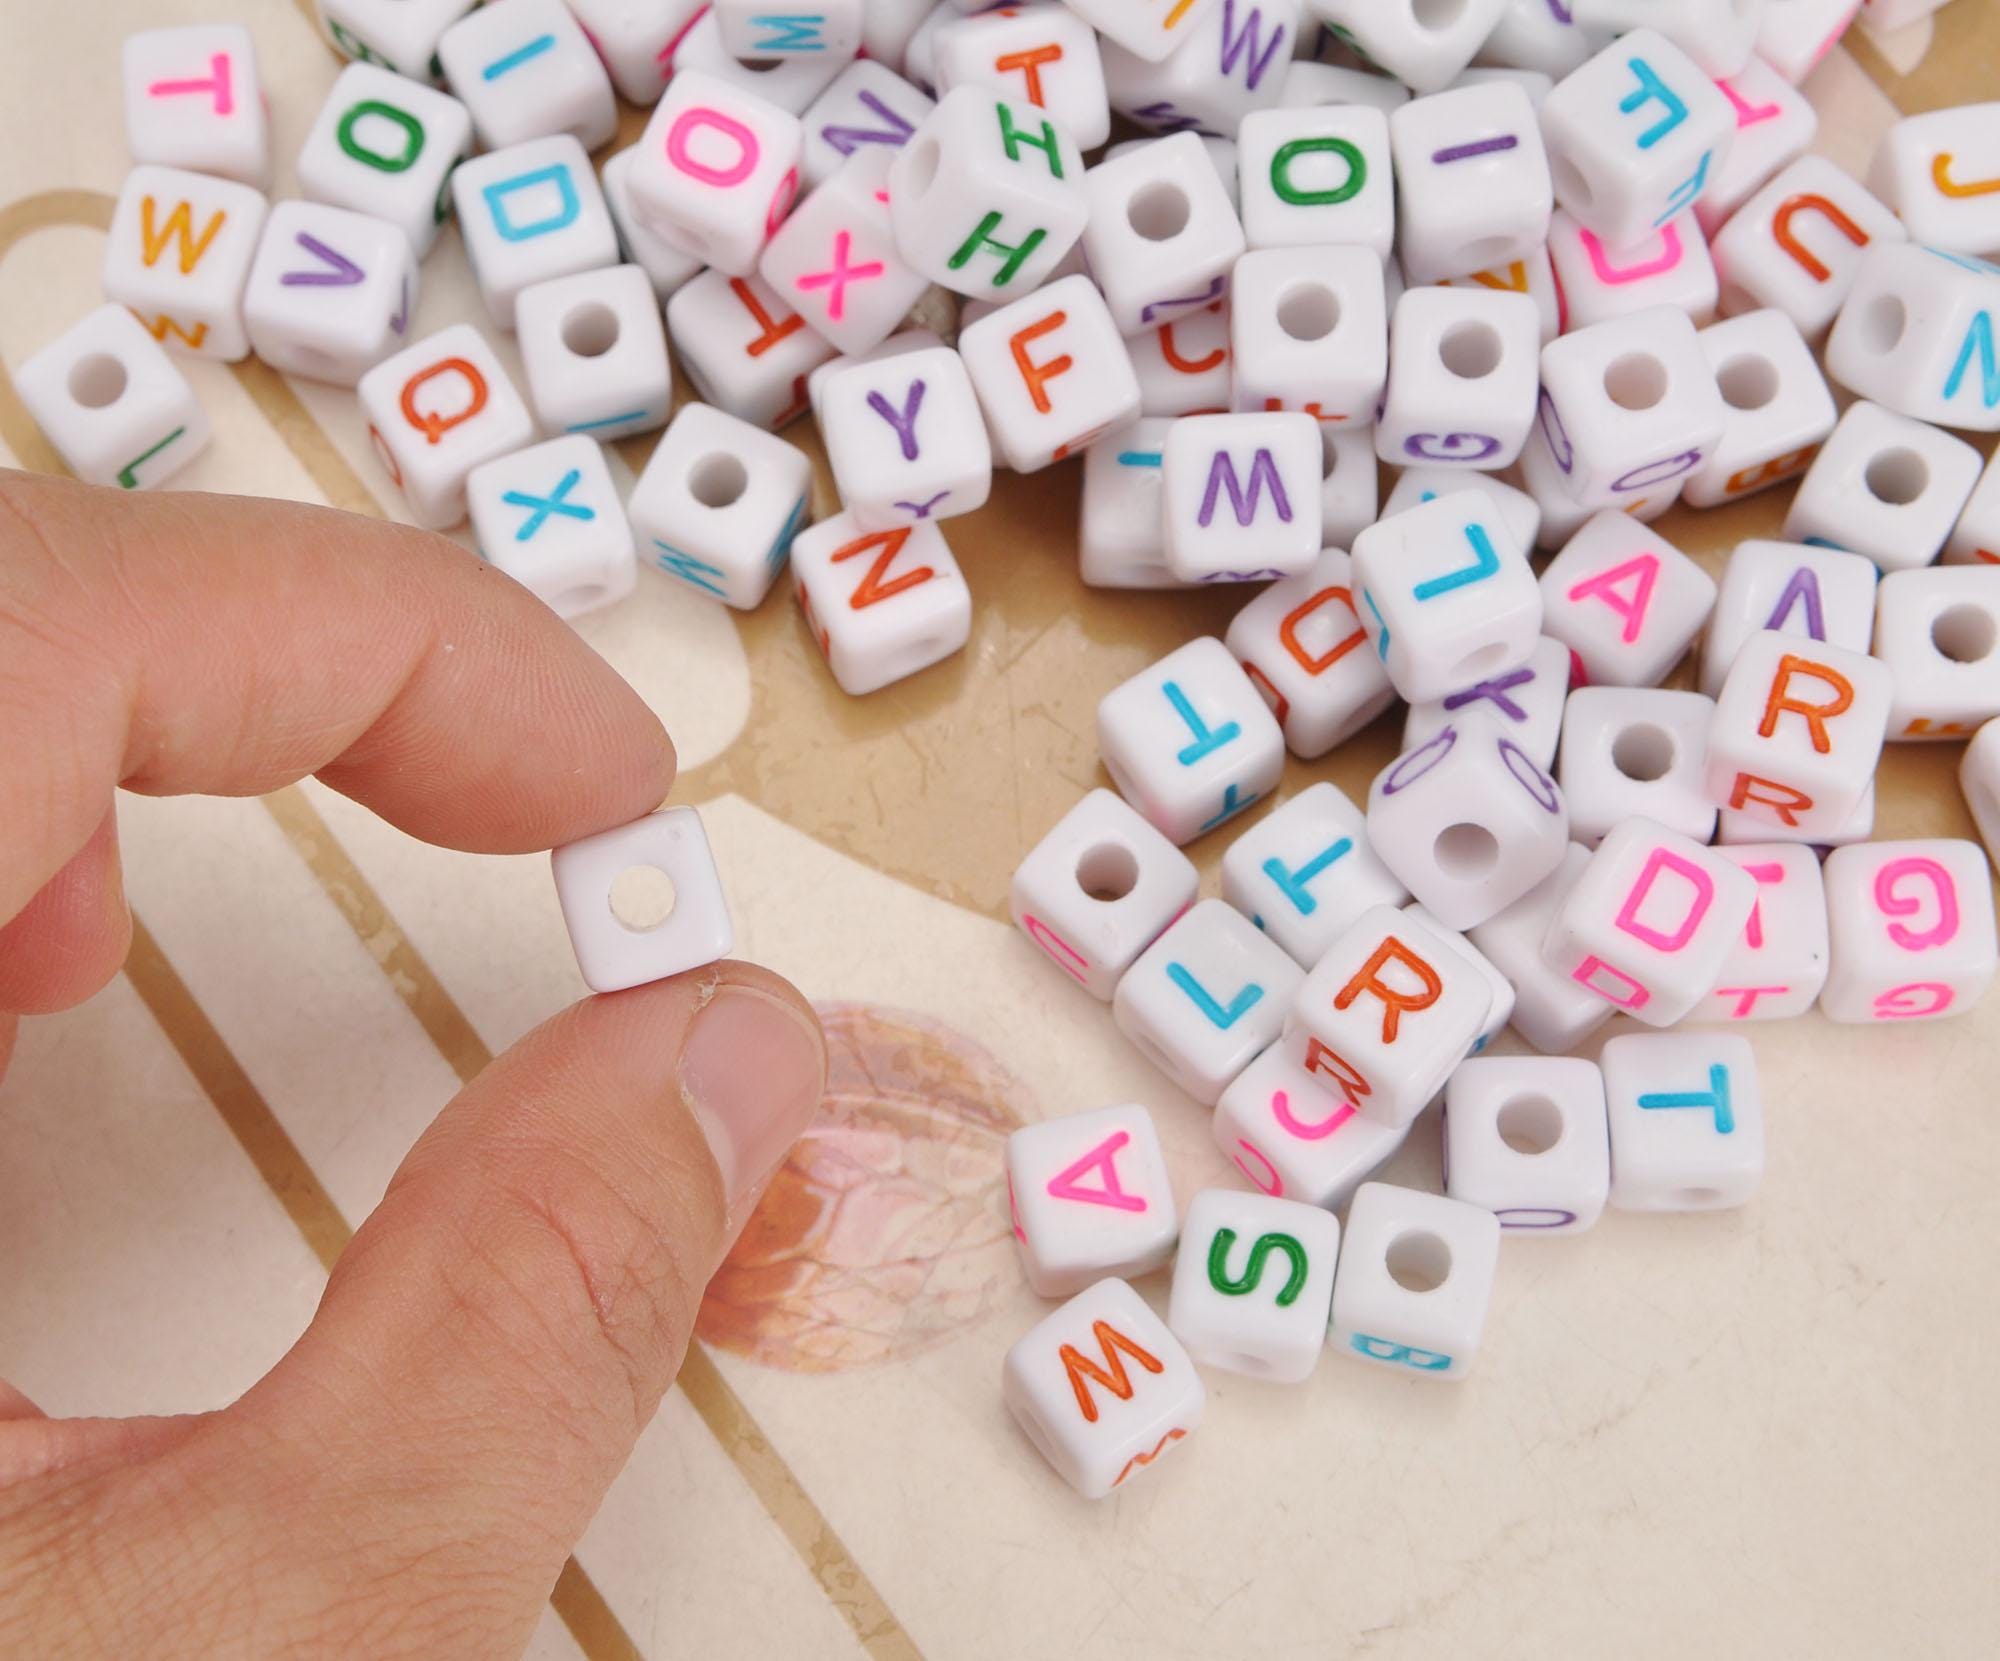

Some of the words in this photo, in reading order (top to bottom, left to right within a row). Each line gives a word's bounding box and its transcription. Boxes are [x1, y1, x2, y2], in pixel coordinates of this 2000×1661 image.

[146, 51, 235, 118] T
[994, 43, 1063, 110] T
[1619, 57, 1689, 150] F
[337, 100, 426, 173] O
[666, 106, 761, 188] O
[996, 102, 1064, 180] H
[1270, 137, 1366, 206] O
[142, 196, 226, 274] W
[482, 163, 580, 242] D
[1772, 193, 1870, 283] U
[795, 229, 885, 321] X
[947, 210, 1047, 287] H
[729, 276, 806, 358] T
[400, 357, 488, 444] Q
[1010, 310, 1073, 414] F
[866, 378, 926, 462] Y
[501, 468, 596, 543] X
[1412, 522, 1502, 603] L
[1567, 553, 1661, 645] A
[1161, 680, 1242, 767] T
[1757, 653, 1855, 754] R
[1262, 837, 1354, 917] T
[1614, 846, 1717, 955] D
[1873, 856, 1961, 952] G
[1165, 961, 1266, 1031] L
[1332, 935, 1443, 1045] R
[1636, 1062, 1736, 1135] T
[1046, 1130, 1149, 1214] A
[1207, 1227, 1309, 1308] S
